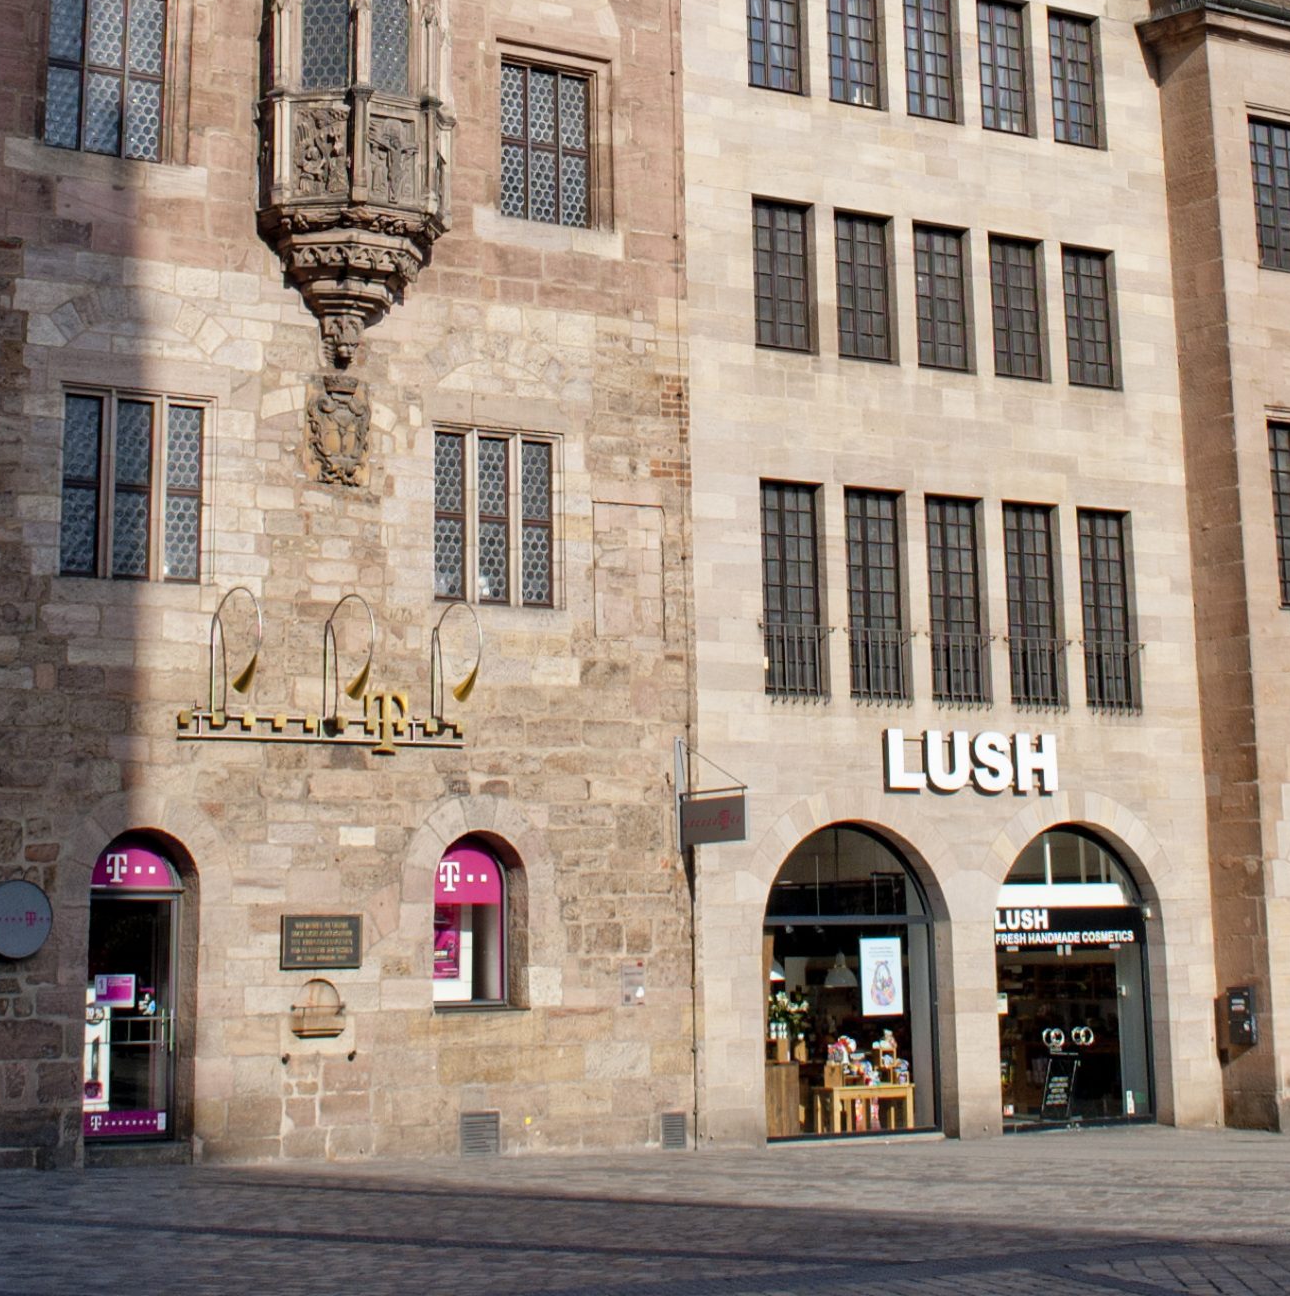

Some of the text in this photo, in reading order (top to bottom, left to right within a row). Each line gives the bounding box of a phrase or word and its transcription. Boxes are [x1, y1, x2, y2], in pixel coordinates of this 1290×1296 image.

[884, 728, 1059, 793] LUSH
[106, 853, 128, 883] T
[439, 862, 460, 892] T
[994, 908, 1050, 930] LUSH
[995, 930, 1135, 945] FRESH HANDMADE COSMETICS
